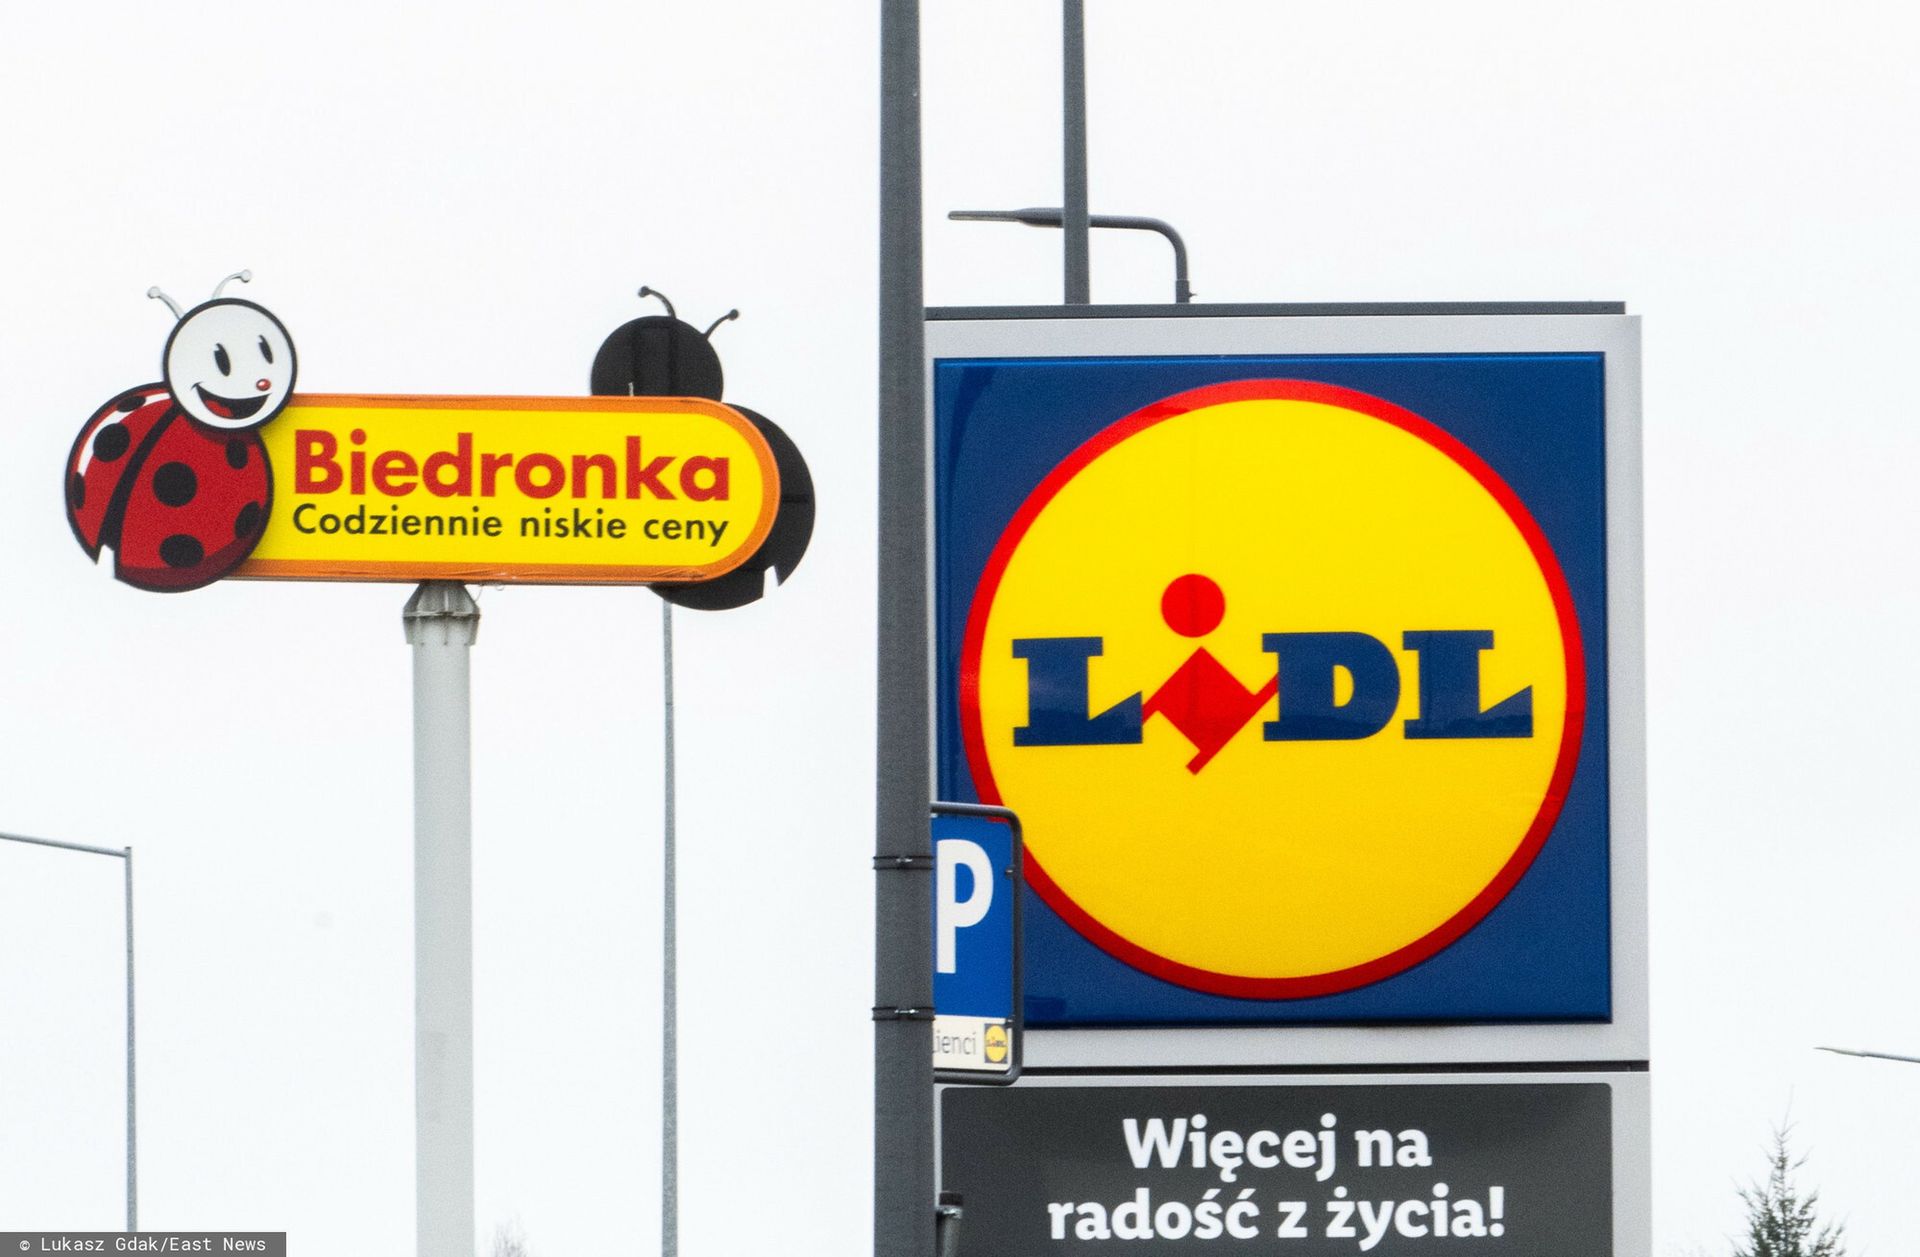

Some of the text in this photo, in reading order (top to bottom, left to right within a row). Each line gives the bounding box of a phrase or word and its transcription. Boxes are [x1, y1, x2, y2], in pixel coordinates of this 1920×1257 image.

[294, 428, 730, 501] Biedronka
[292, 503, 729, 547] Codziennie niskie ceny
[936, 838, 994, 974] P
[933, 1027, 977, 1056] ienci
[1122, 1112, 1433, 1182] Więcej na
[1047, 1182, 1506, 1252] radość z życia!
